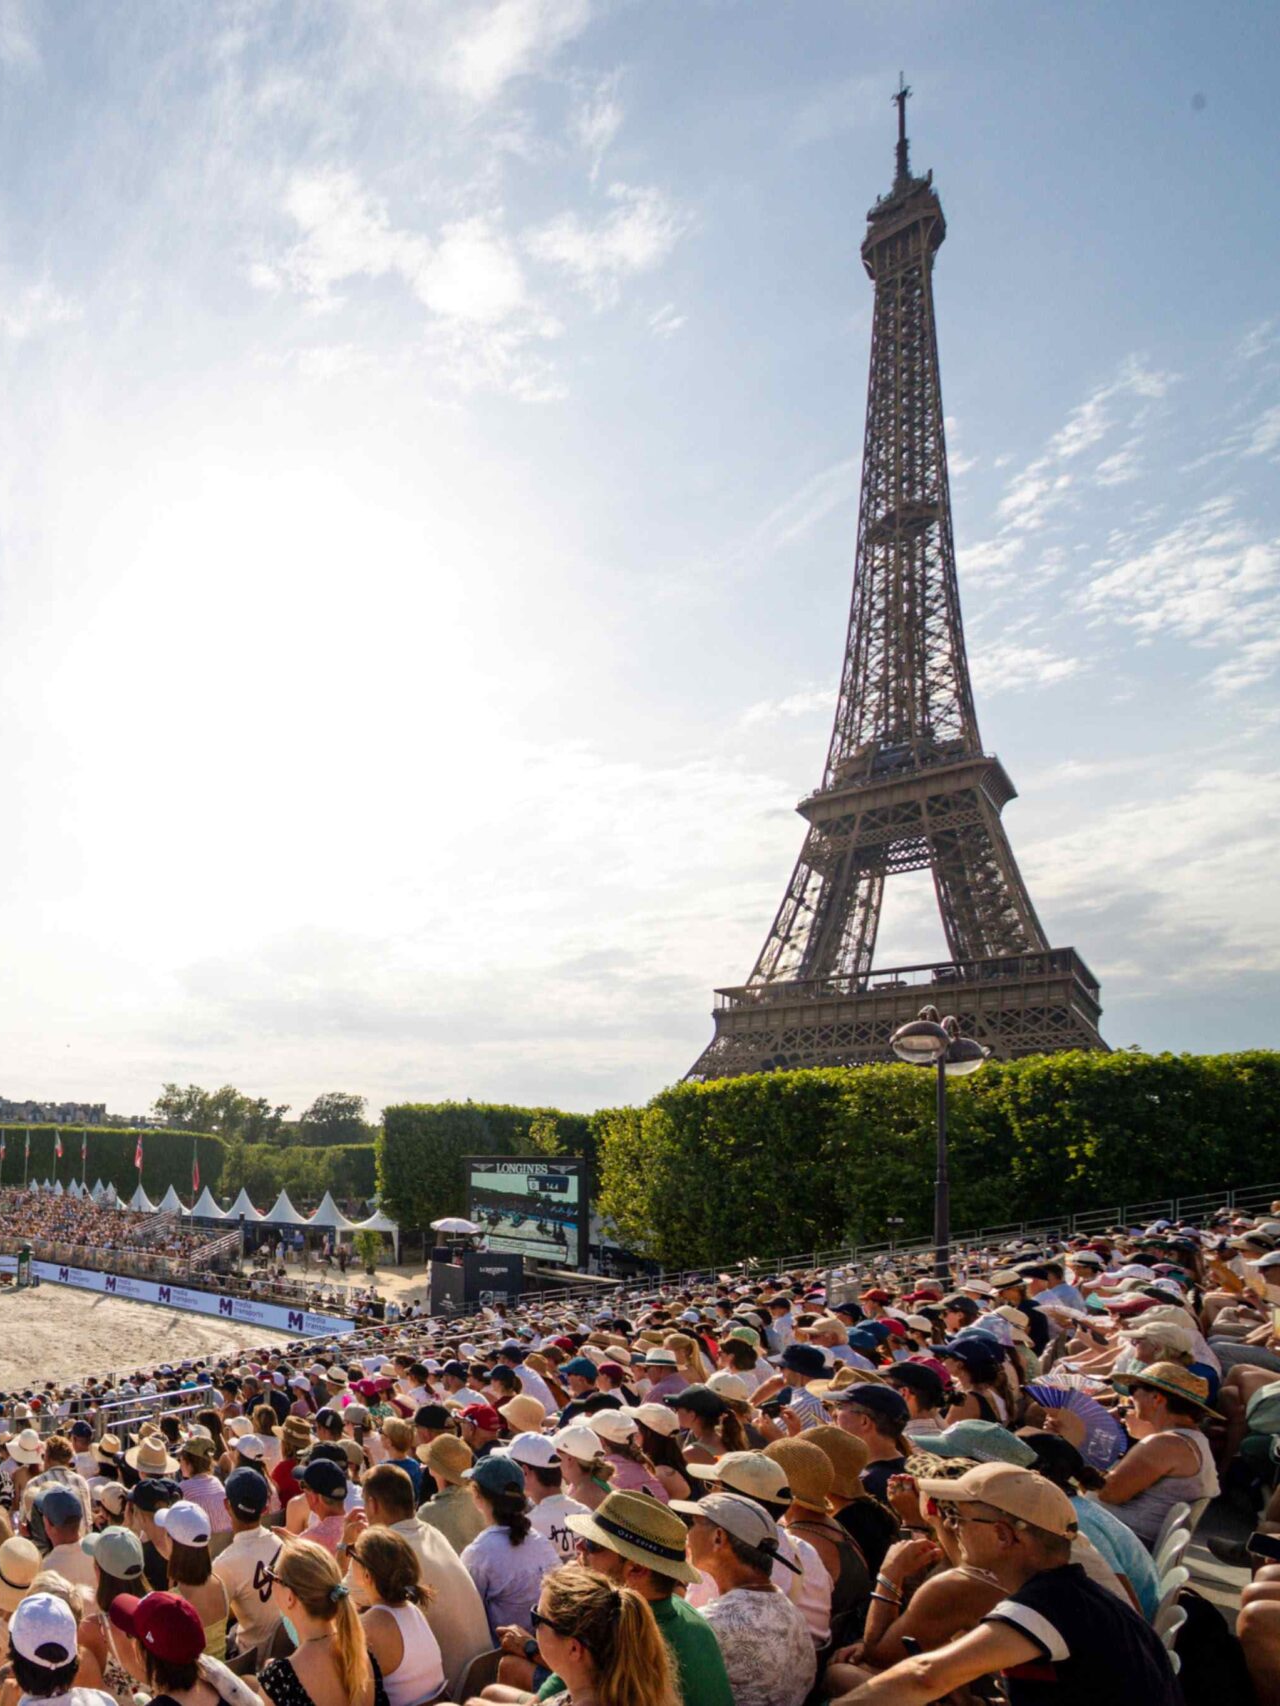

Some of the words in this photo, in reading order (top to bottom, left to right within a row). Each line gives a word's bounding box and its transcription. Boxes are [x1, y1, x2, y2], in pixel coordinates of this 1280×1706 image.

[496, 1163, 548, 1174] LONGINES
[158, 1286, 170, 1302] M
[219, 1298, 233, 1316] M
[234, 1301, 251, 1309] media
[234, 1306, 263, 1319] transports
[288, 1311, 303, 1331] M
[306, 1315, 326, 1324] media
[305, 1320, 340, 1333] transports
